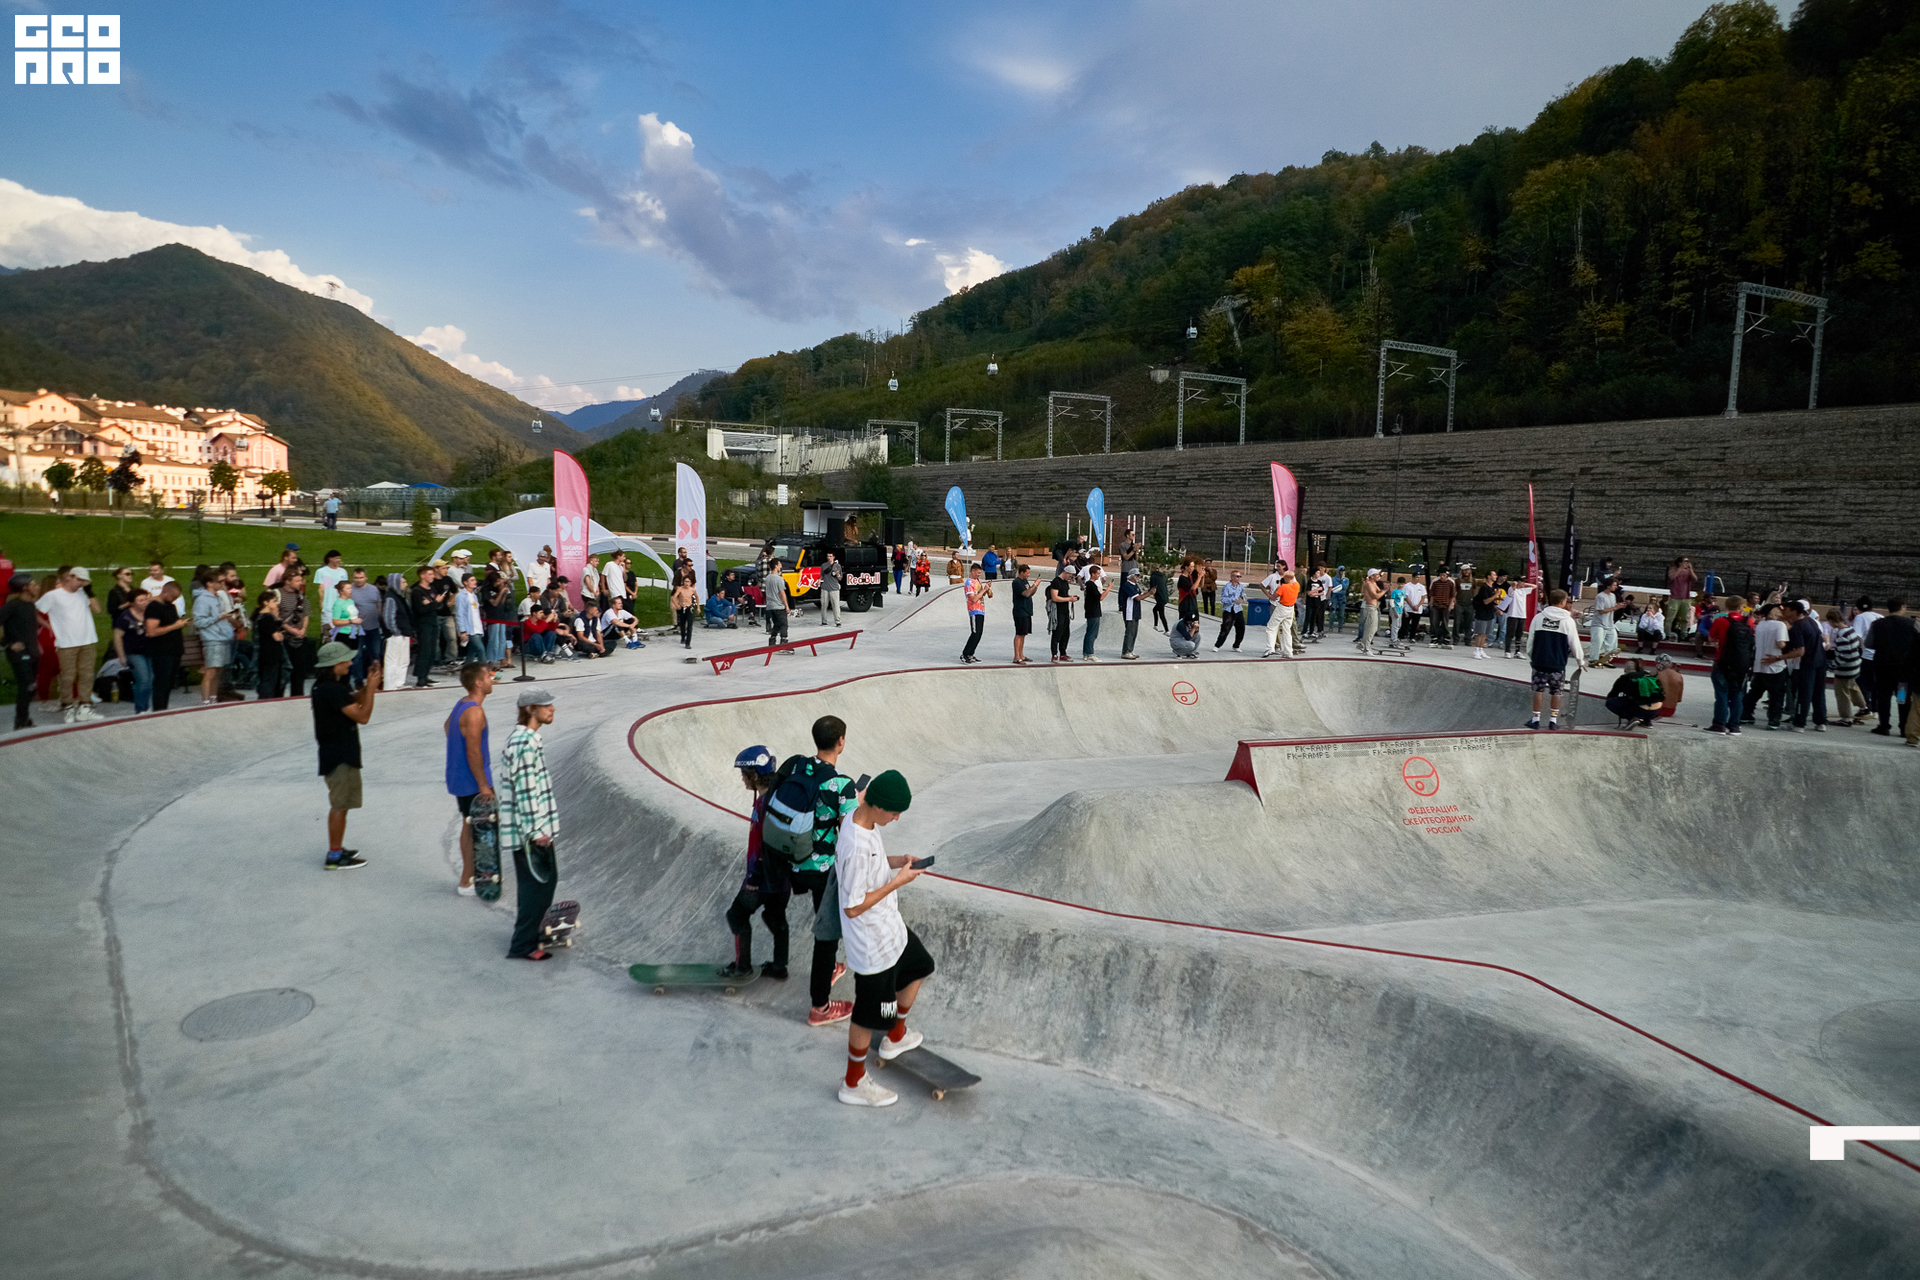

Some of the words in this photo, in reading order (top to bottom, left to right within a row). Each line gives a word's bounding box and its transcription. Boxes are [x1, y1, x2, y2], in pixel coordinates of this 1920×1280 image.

[846, 572, 864, 585] Red
[864, 572, 880, 585] Bull
[1295, 744, 1338, 752] FK-RAMPS
[1380, 741, 1420, 749] FK-RAMPS
[1460, 737, 1498, 745] FK-RAMPS
[1287, 752, 1331, 760] FK-RAMPS
[1372, 748, 1413, 756] FK-RAMPS
[1408, 805, 1459, 815] ФЕДЕРАЦИЯ
[1402, 815, 1475, 826] СКЕЙТБОРДИНГА
[1426, 826, 1462, 834] РОССИИ
